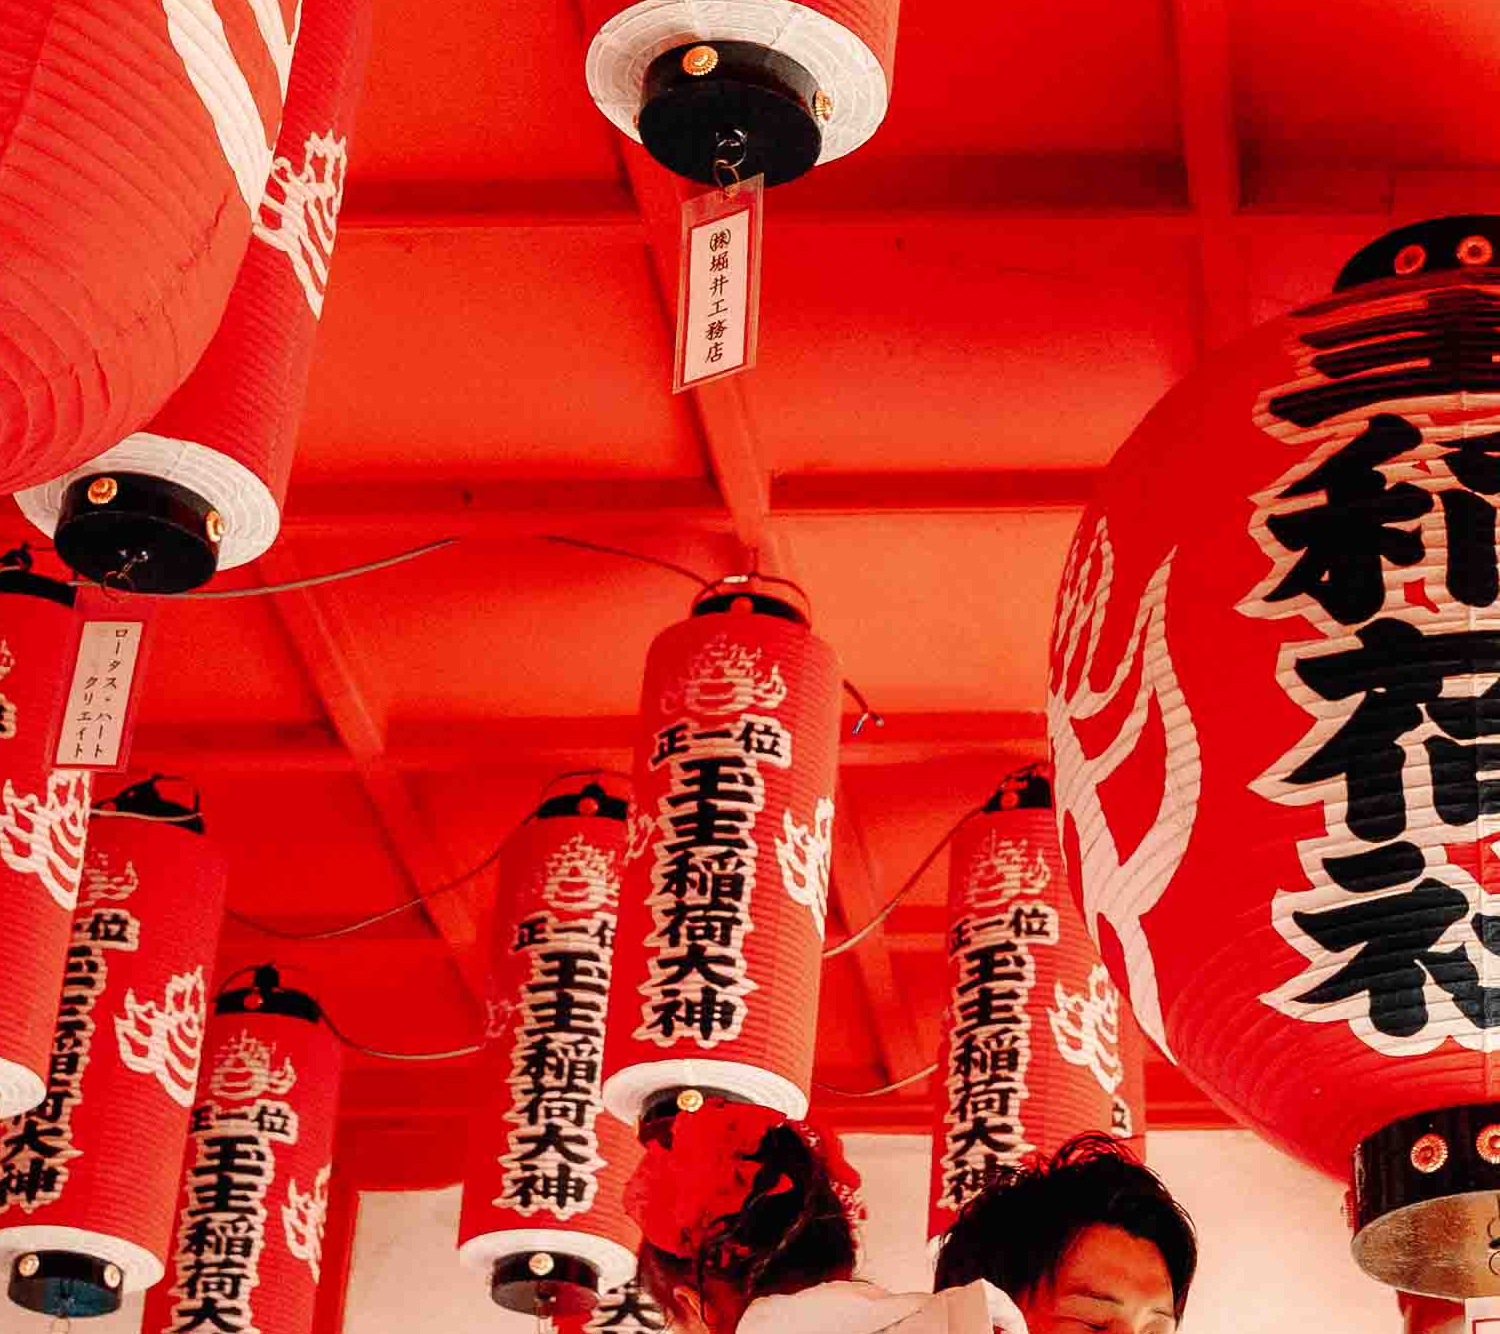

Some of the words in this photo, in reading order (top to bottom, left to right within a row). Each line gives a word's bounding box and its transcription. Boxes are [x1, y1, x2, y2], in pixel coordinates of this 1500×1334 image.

[653, 719, 784, 761] 正一位
[652, 758, 754, 1042] 玉主稲荷大神
[506, 952, 608, 1210] 玉主稲荷大神
